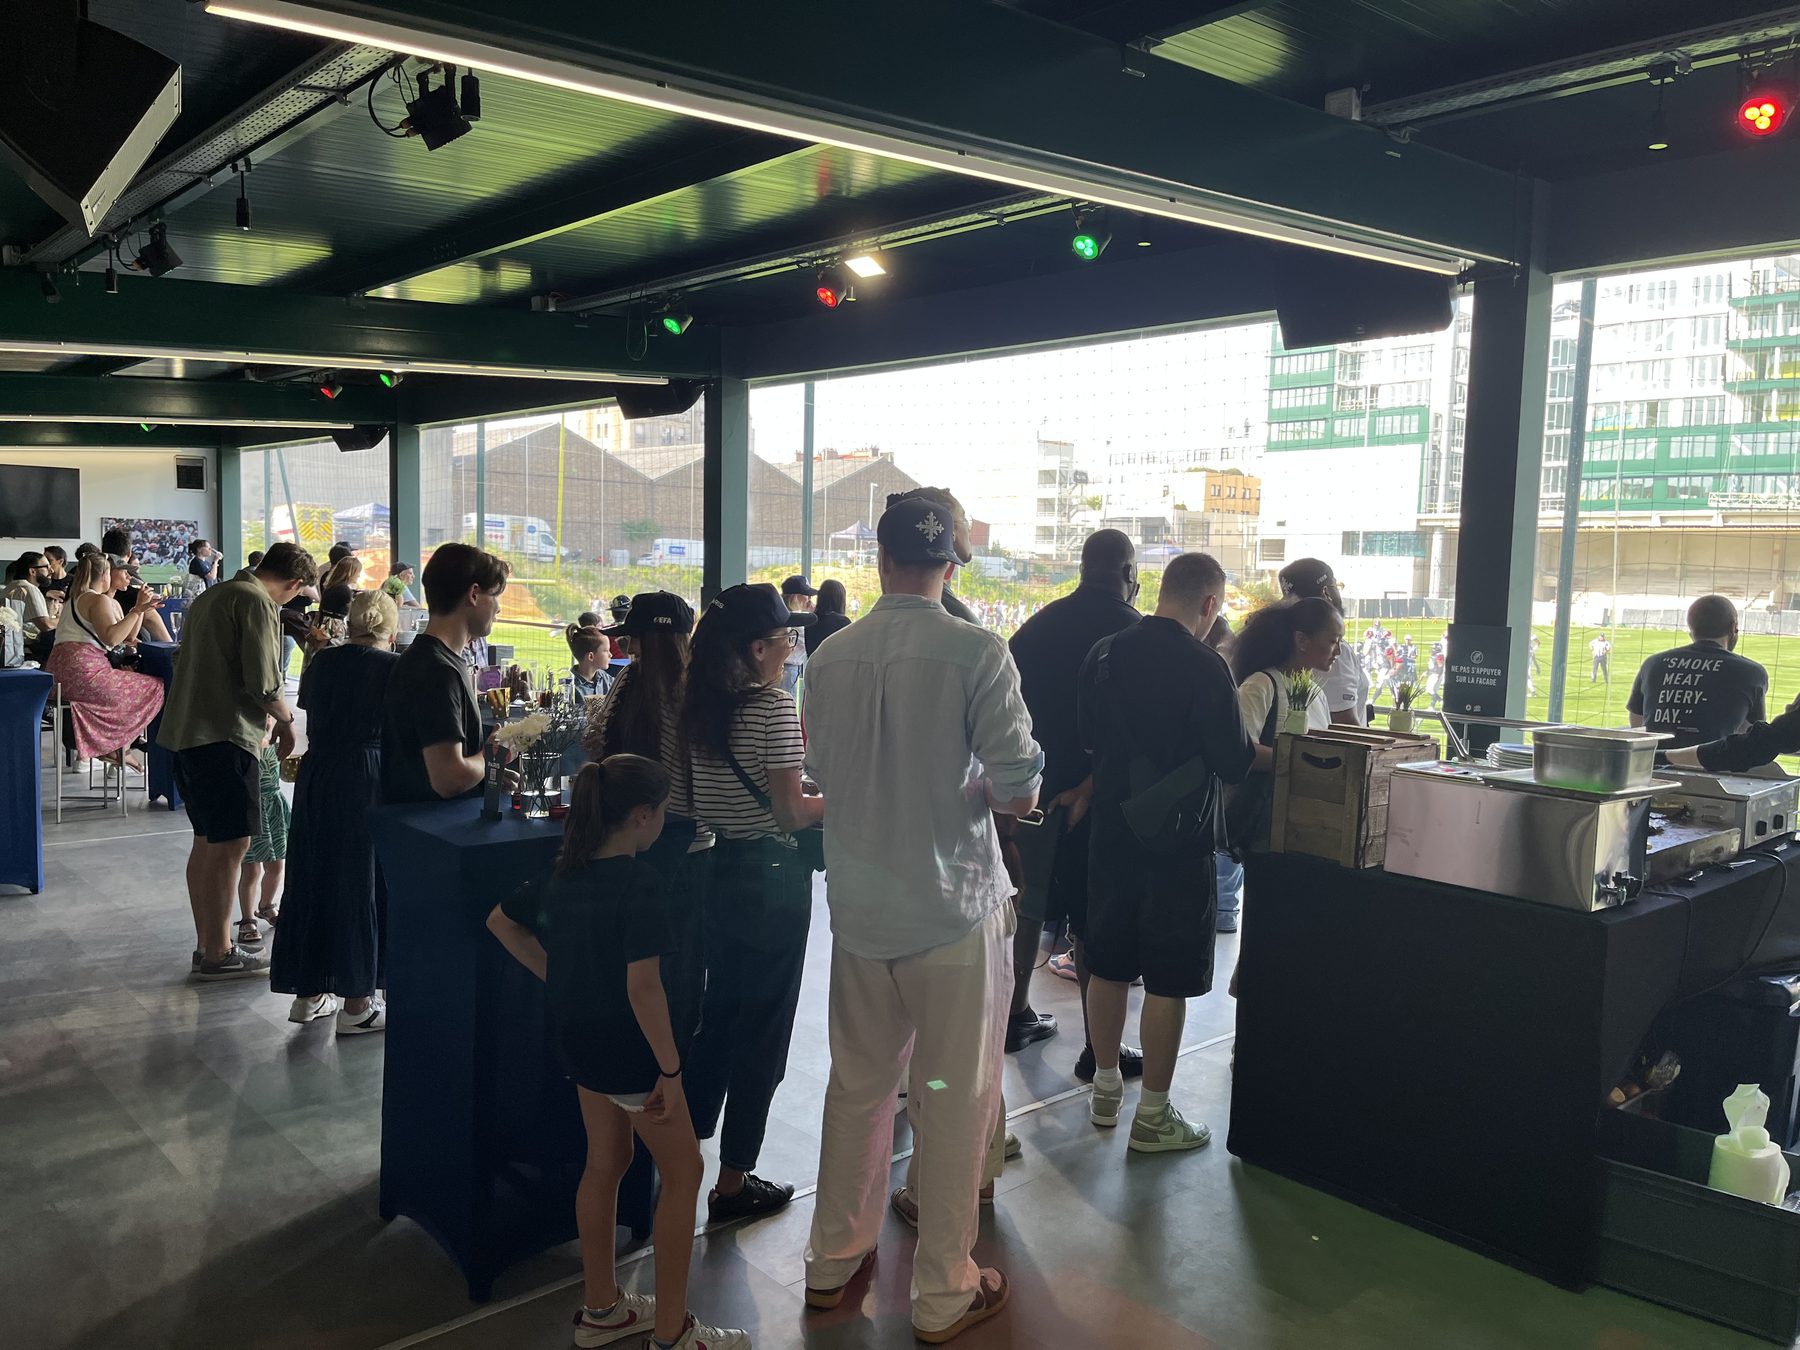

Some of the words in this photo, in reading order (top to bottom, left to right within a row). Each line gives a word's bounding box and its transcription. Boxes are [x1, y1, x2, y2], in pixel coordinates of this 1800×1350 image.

[1450, 664, 1459, 673] NE
[1460, 665, 1470, 674] PAS
[1471, 666, 1502, 676] S'APPUYER
[1455, 675, 1467, 683] SUR
[1467, 676, 1475, 684] LA
[1662, 673, 1703, 686] MEAT
[1658, 689, 1708, 705] EVERY-
